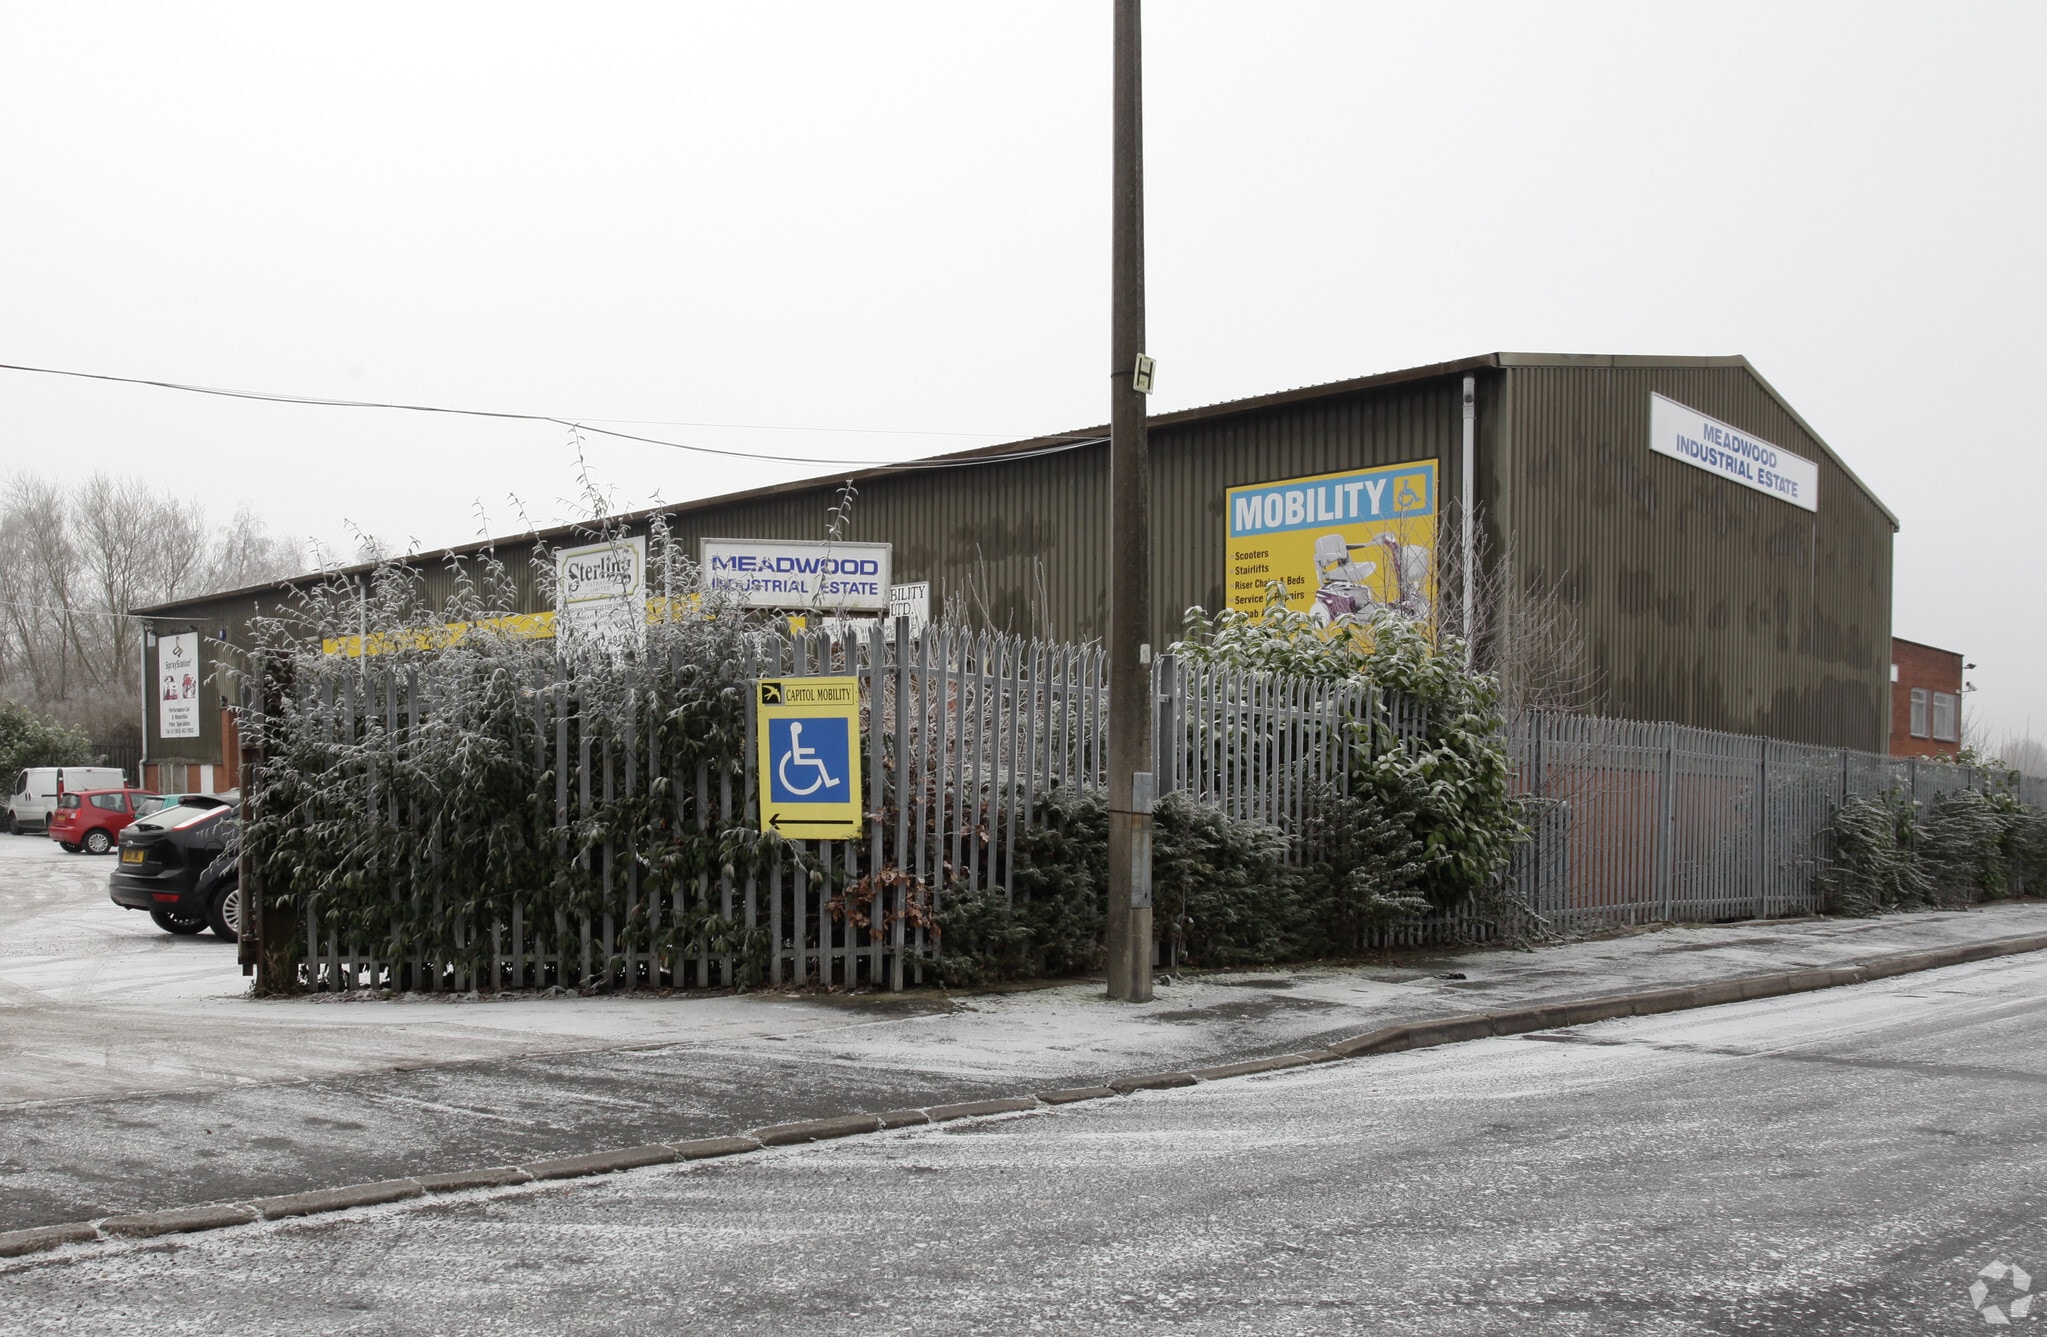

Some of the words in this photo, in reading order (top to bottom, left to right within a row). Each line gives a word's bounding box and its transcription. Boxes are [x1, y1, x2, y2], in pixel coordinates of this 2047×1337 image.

[1703, 423, 1777, 469] MEADWOOD
[1676, 434, 1753, 481] INDUSTRIAL
[1758, 467, 1798, 498] ESTATE
[1235, 479, 1387, 531] MOBILITY
[1235, 550, 1269, 560] Scooters
[568, 555, 632, 592] Sterling
[711, 555, 879, 576] MEADWOOD
[1235, 564, 1269, 575] Stairlifts
[711, 578, 809, 593] INUSTRIAL
[821, 580, 879, 596] ESTATE
[1235, 580, 1253, 590] Riser
[1287, 575, 1305, 585] Beds
[890, 585, 926, 602] BILITY
[1235, 594, 1264, 605] Service
[1274, 591, 1305, 602] Rpairs
[786, 689, 815, 702] CAPITOL
[817, 687, 851, 701] MOBILITY
